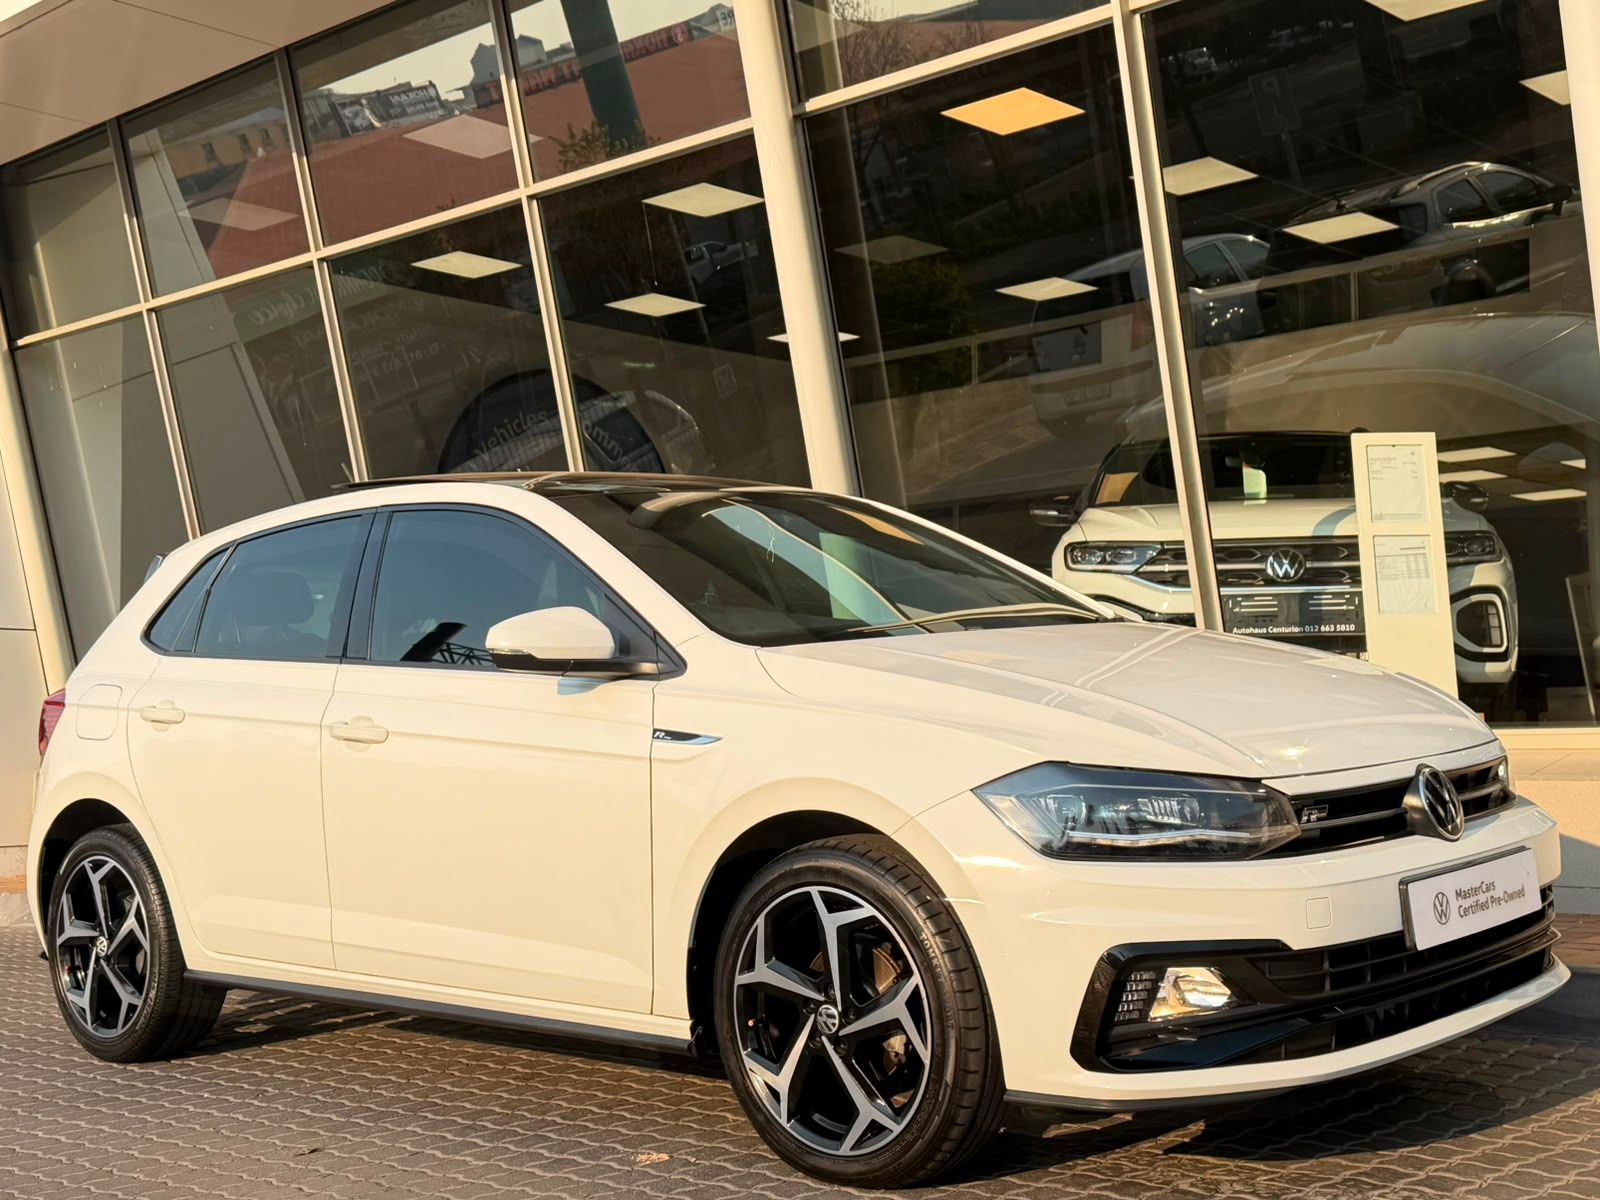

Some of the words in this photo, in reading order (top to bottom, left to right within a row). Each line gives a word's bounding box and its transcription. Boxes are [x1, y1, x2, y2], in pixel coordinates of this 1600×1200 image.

[473, 408, 550, 459] Vehicles
[1232, 626, 1267, 634] Autohaus
[1268, 625, 1304, 634] Centurion
[1305, 624, 1319, 632] 012
[1320, 624, 1335, 632] 663
[1336, 624, 1356, 632] 5810
[1455, 880, 1496, 902] MasterCars
[1458, 899, 1490, 918] Certified
[1490, 886, 1526, 910] Pre-Owned
